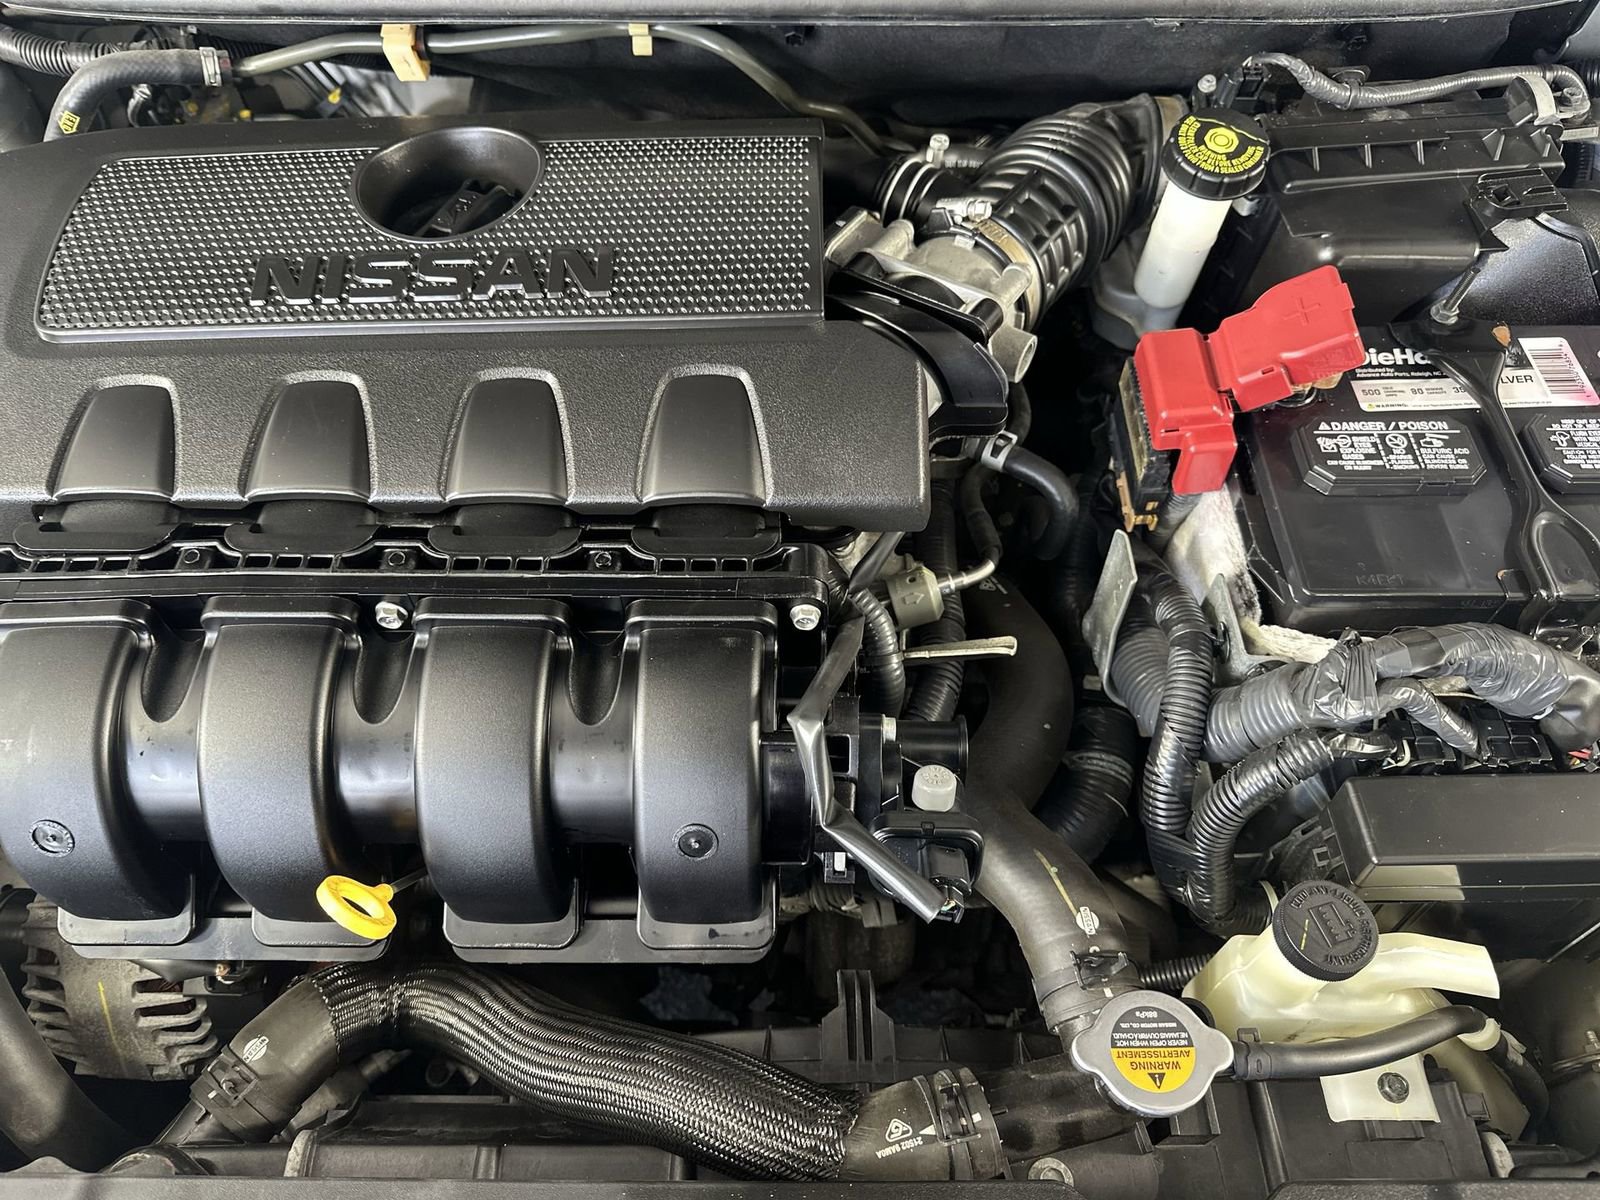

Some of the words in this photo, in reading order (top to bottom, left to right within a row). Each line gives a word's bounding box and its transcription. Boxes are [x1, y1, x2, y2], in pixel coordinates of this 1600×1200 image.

[1195, 152, 1209, 161] CAP
[1207, 157, 1232, 167] BEFORE
[1198, 144, 1227, 161] WARNING
[1196, 160, 1215, 173] FROM
[1220, 165, 1244, 174] SEALED
[249, 248, 614, 306] NISSAN
[1499, 374, 1534, 384] LVER
[1330, 421, 1387, 431] DANGER
[1398, 421, 1449, 430] POISON
[1116, 1050, 1190, 1059] AVERTISSEMENT
[1130, 1061, 1181, 1070] WARNING
[899, 1136, 924, 1151] 21502
